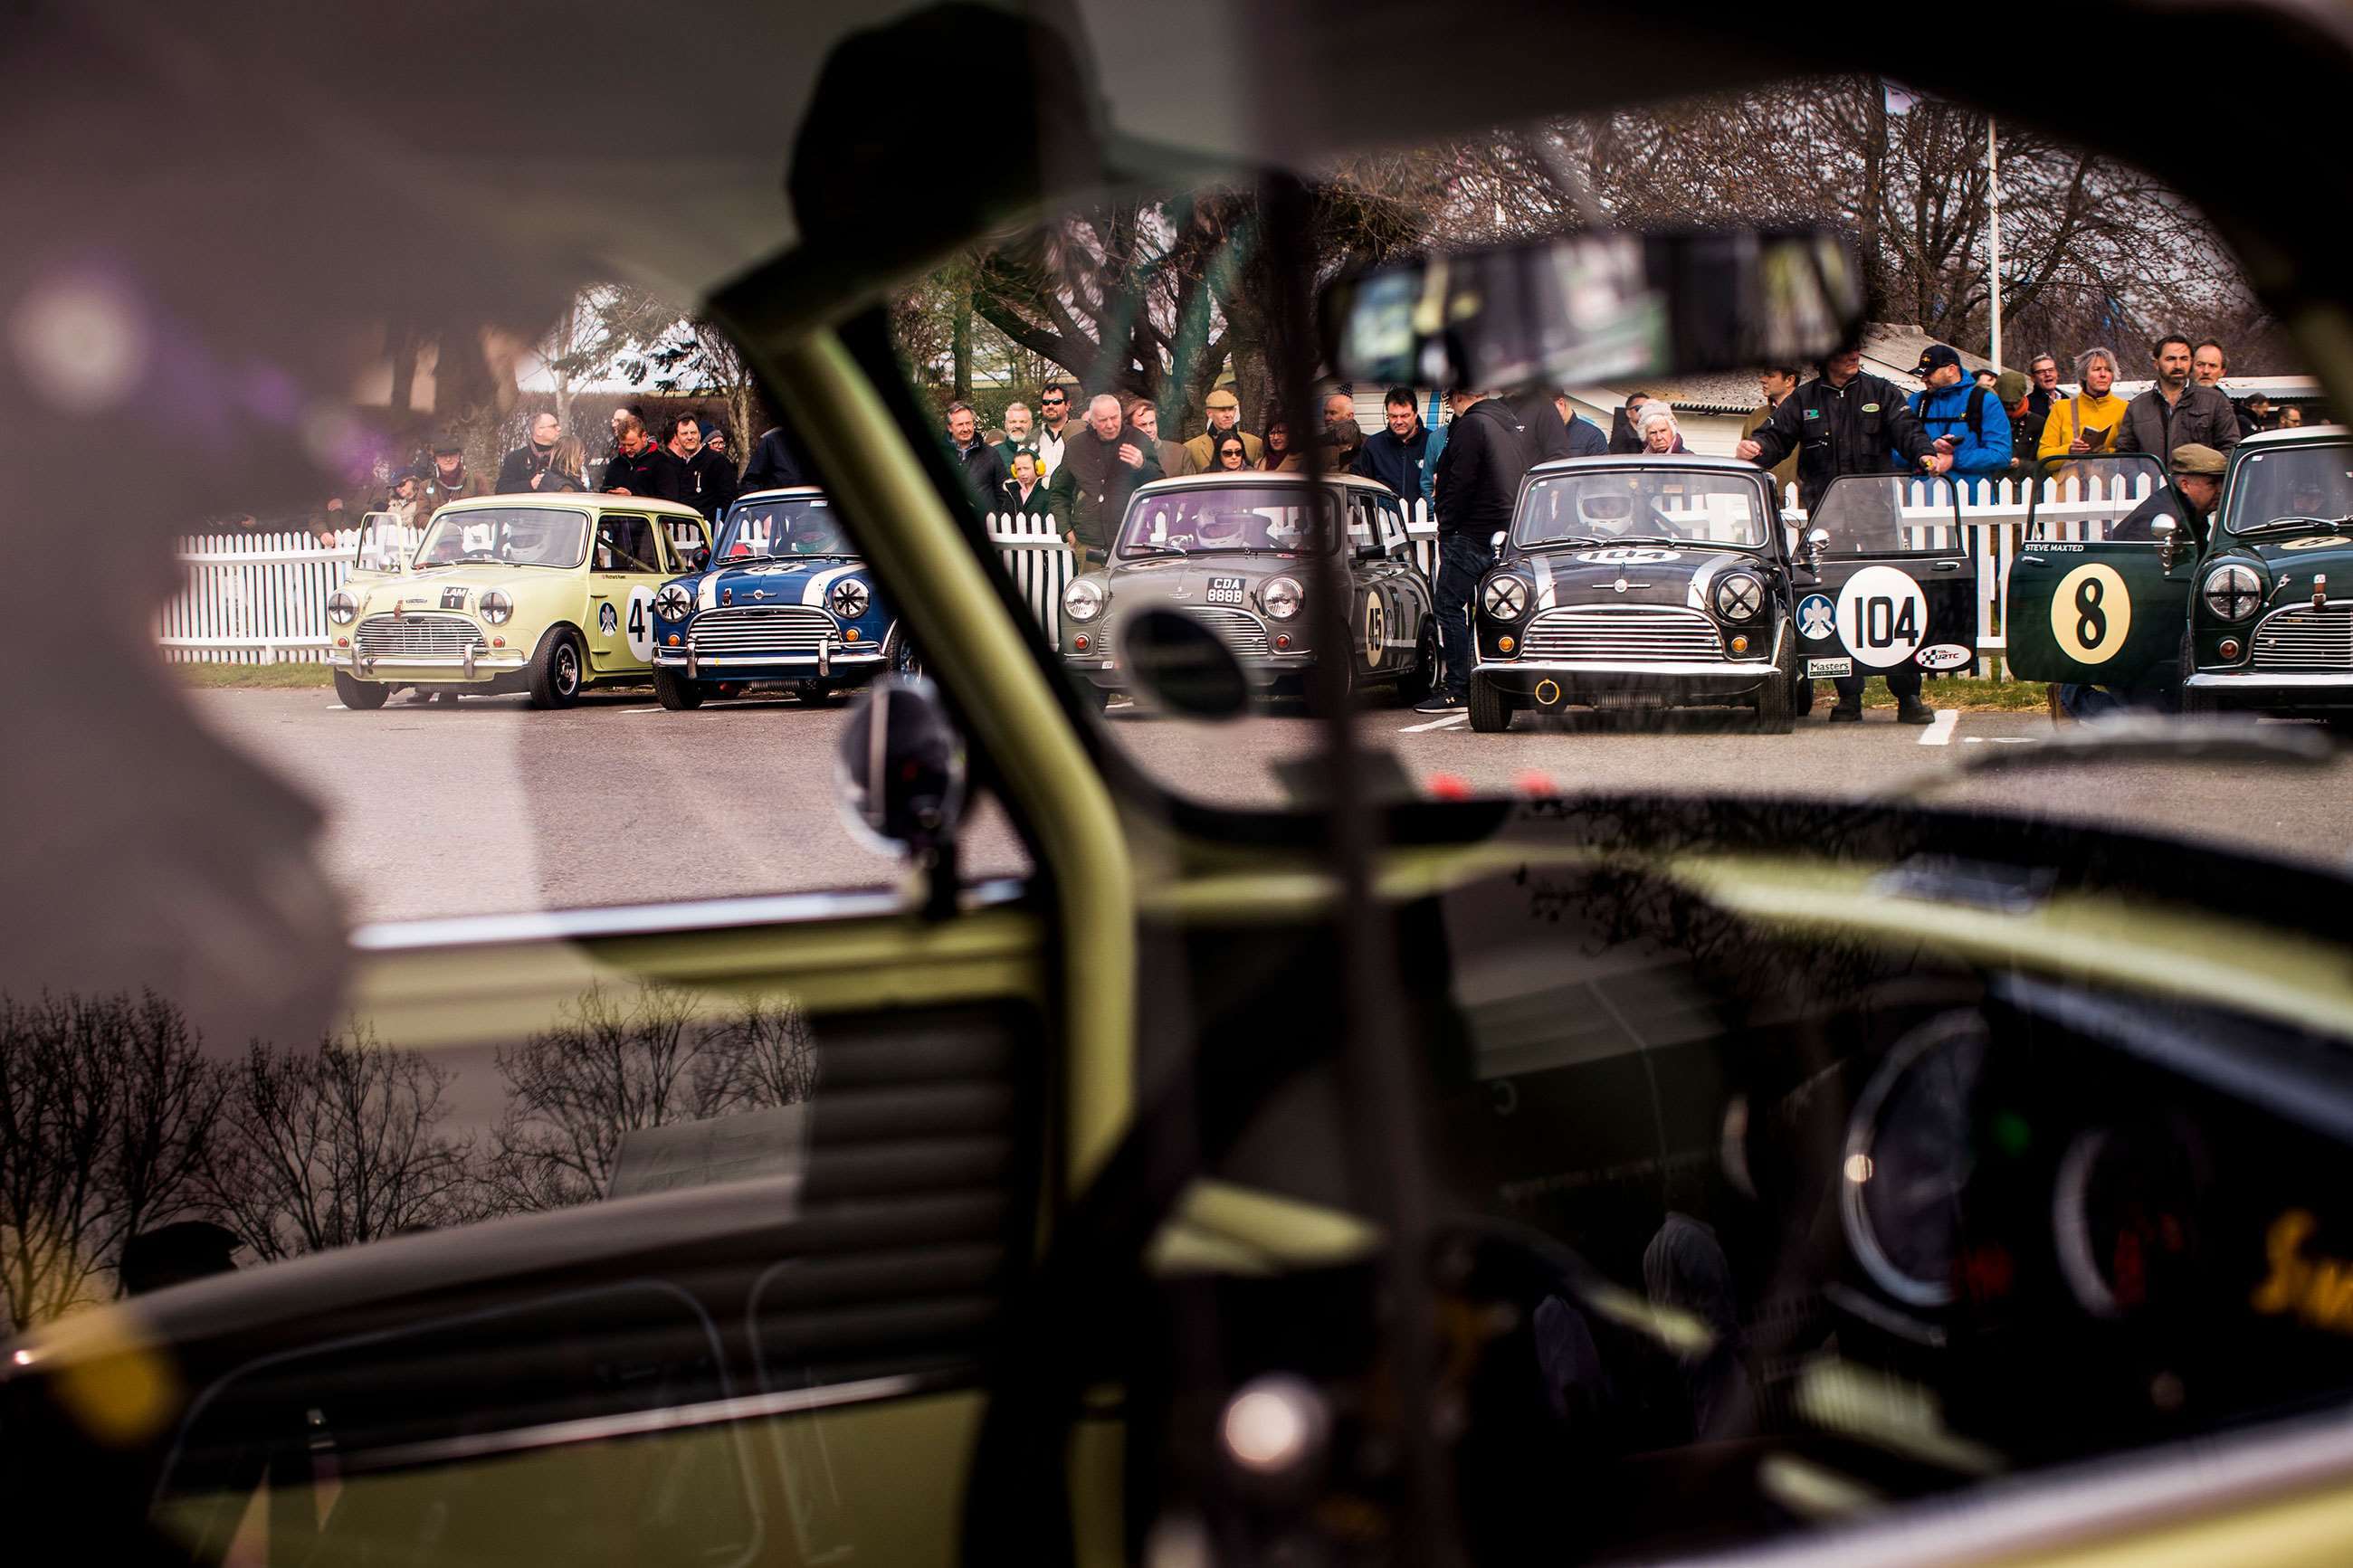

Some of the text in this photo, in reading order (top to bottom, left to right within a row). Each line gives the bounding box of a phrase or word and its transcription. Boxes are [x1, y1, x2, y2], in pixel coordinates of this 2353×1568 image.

[2024, 544, 2084, 552] STEVE MAXTED
[1589, 550, 1665, 560] 104
[1214, 578, 1240, 589] CDA
[443, 586, 466, 597] LAM
[1207, 589, 1243, 603] 888B
[450, 597, 455, 607] 1
[2075, 577, 2107, 650] 8
[1854, 596, 1919, 648] 104
[1367, 607, 1382, 651] 45
[1810, 662, 1849, 670] Masters
